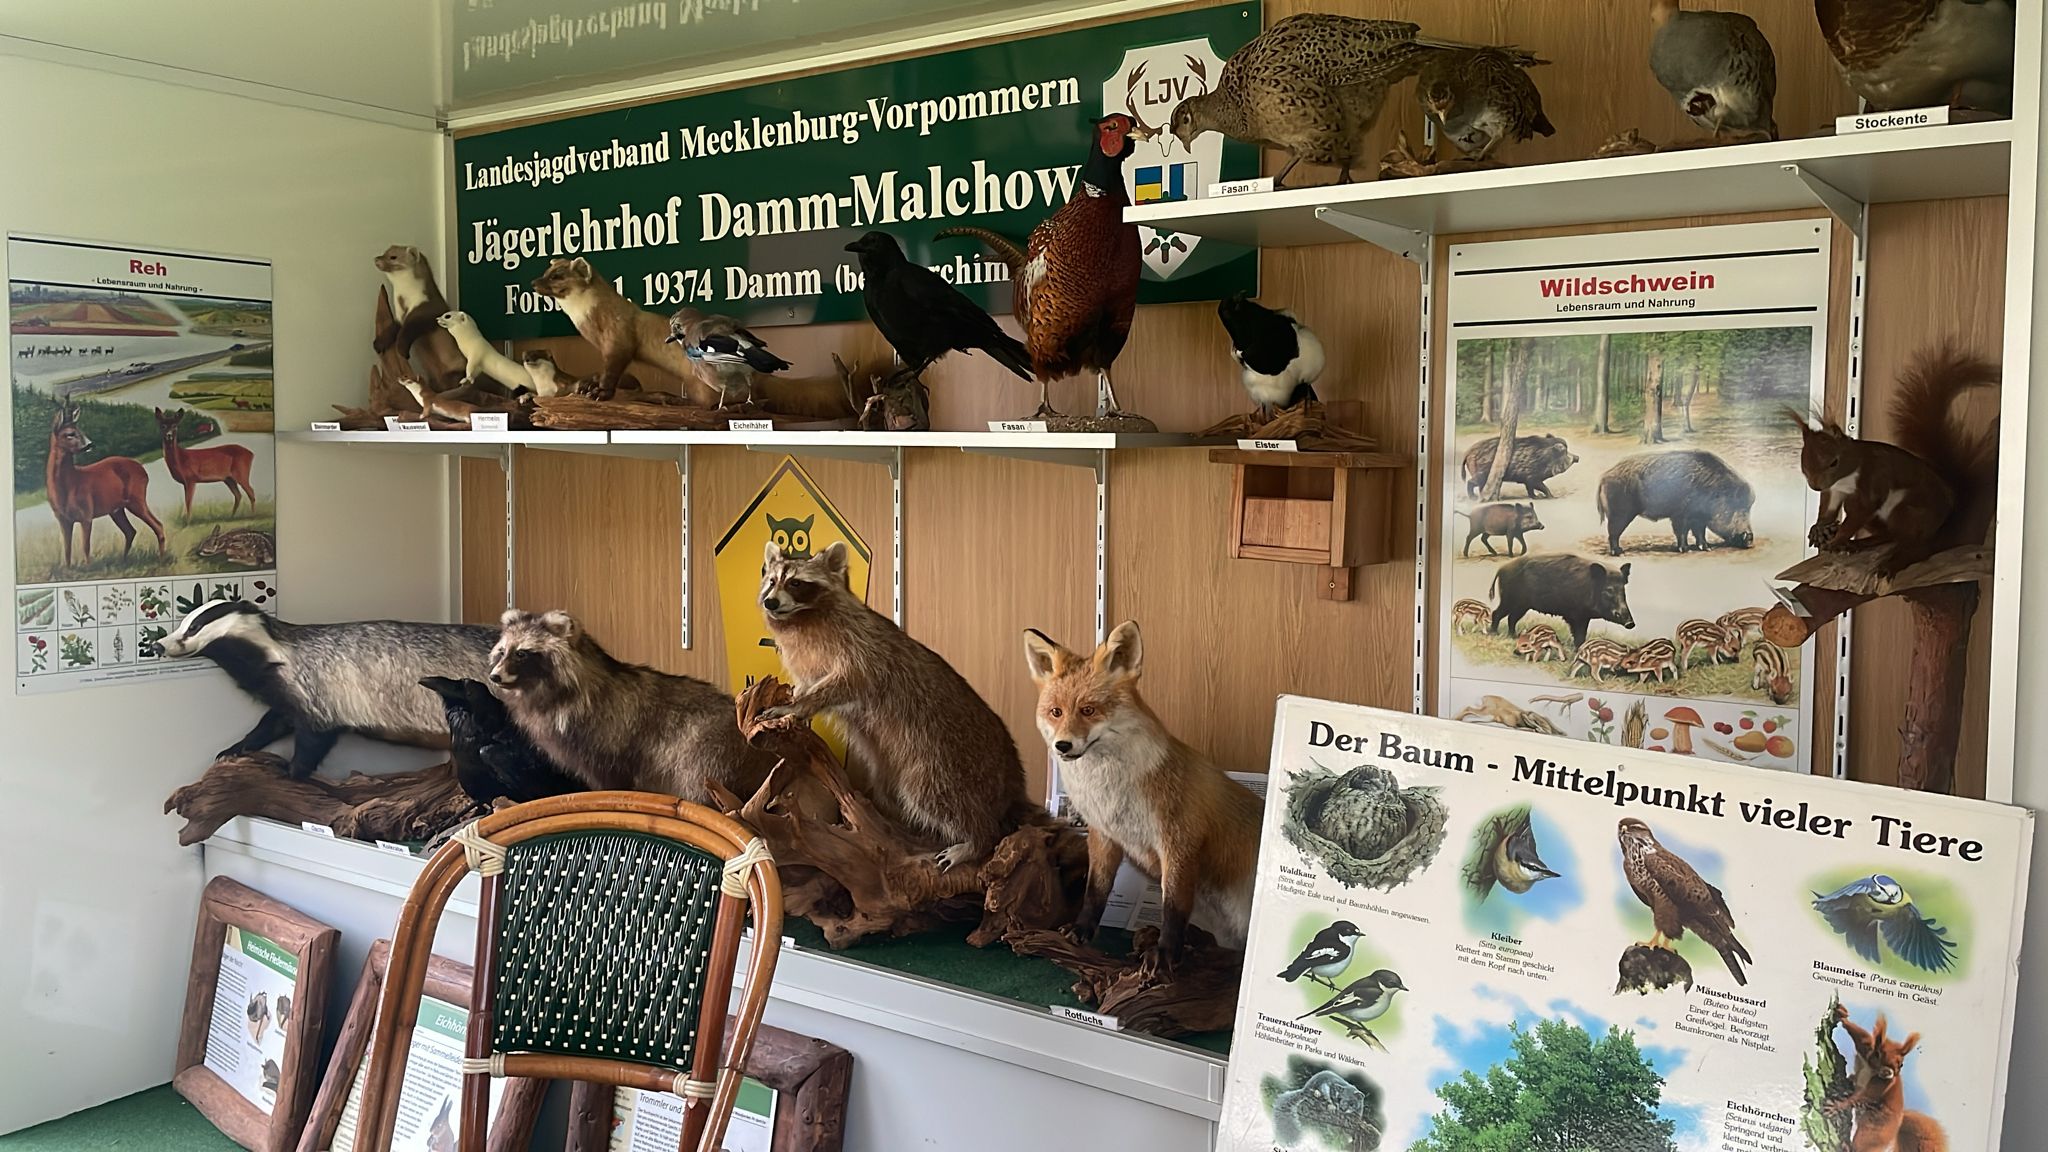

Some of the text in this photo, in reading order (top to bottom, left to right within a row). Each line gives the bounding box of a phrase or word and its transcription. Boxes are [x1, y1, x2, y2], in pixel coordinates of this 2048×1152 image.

[1144, 76, 1189, 106] LJV
[1855, 114, 1928, 129] Stockente
[465, 77, 1081, 191] Landesjagdverband Mecklenburg-Vorpommern
[1221, 184, 1249, 194] Fasan
[468, 160, 1083, 271] Jägerlehrhof Damm-Malchow
[130, 259, 167, 276] Reh
[96, 277, 147, 288] Lebensraum
[148, 282, 163, 290] und
[165, 283, 198, 293] Nahrung
[643, 268, 713, 306] 19374
[724, 266, 823, 301] Damm
[1540, 271, 1715, 298] Wildschwein
[1556, 298, 1696, 313] Lebensraum und Nahrung
[1001, 422, 1026, 431] Fasan
[1255, 441, 1280, 449] Elster
[1308, 720, 1369, 754] Der
[1378, 732, 1475, 774] Baum
[1511, 755, 1726, 818] Mittelpunkt
[1739, 798, 1852, 839] vieler
[1871, 814, 1984, 863] Tiere
[1280, 865, 1317, 880] Waldkauz
[1307, 890, 1322, 900] Eule
[1323, 894, 1336, 903] und
[1349, 900, 1389, 915] Baumhöhlen
[1478, 940, 1534, 959] (Sitta europaea)
[1491, 932, 1523, 945] Kleiber
[1455, 944, 1555, 973] Klettert am Stamm geschickt
[1457, 955, 1549, 981] mit dem Kopf nach unten.
[1813, 960, 1867, 979] Blaumeise
[1870, 973, 1897, 986] (Parus
[1696, 984, 1767, 1008] Mäusebussard
[1812, 971, 1854, 988] Gewandte
[1858, 981, 1894, 997] Turnerin
[1897, 991, 1909, 1000] im
[1064, 1009, 1103, 1026] Rotfuchs
[1689, 1004, 1768, 1030] Einer der häufigsten
[1703, 997, 1757, 1017] (Buteo buteo)
[1255, 1021, 1319, 1045] (Ficedula hypoleuca)
[1258, 1012, 1323, 1036] Trauerschnäpper
[1675, 1021, 1725, 1041] Baumkronen
[1727, 1035, 1738, 1043] als
[1730, 1024, 1770, 1041] Bevorzugt
[1254, 1031, 1367, 1068] Höhlenbrüter in Parks und Wäldern.
[640, 1092, 669, 1110] Trommler
[669, 1104, 683, 1114] und
[1726, 1100, 1796, 1125] Eichhörnchen
[1724, 1122, 1783, 1144] Springend und
[1725, 1111, 1792, 1136] (Sciurus vulgaris)
[1722, 1142, 1734, 1152] die
[1723, 1132, 1759, 1148] kletternd
